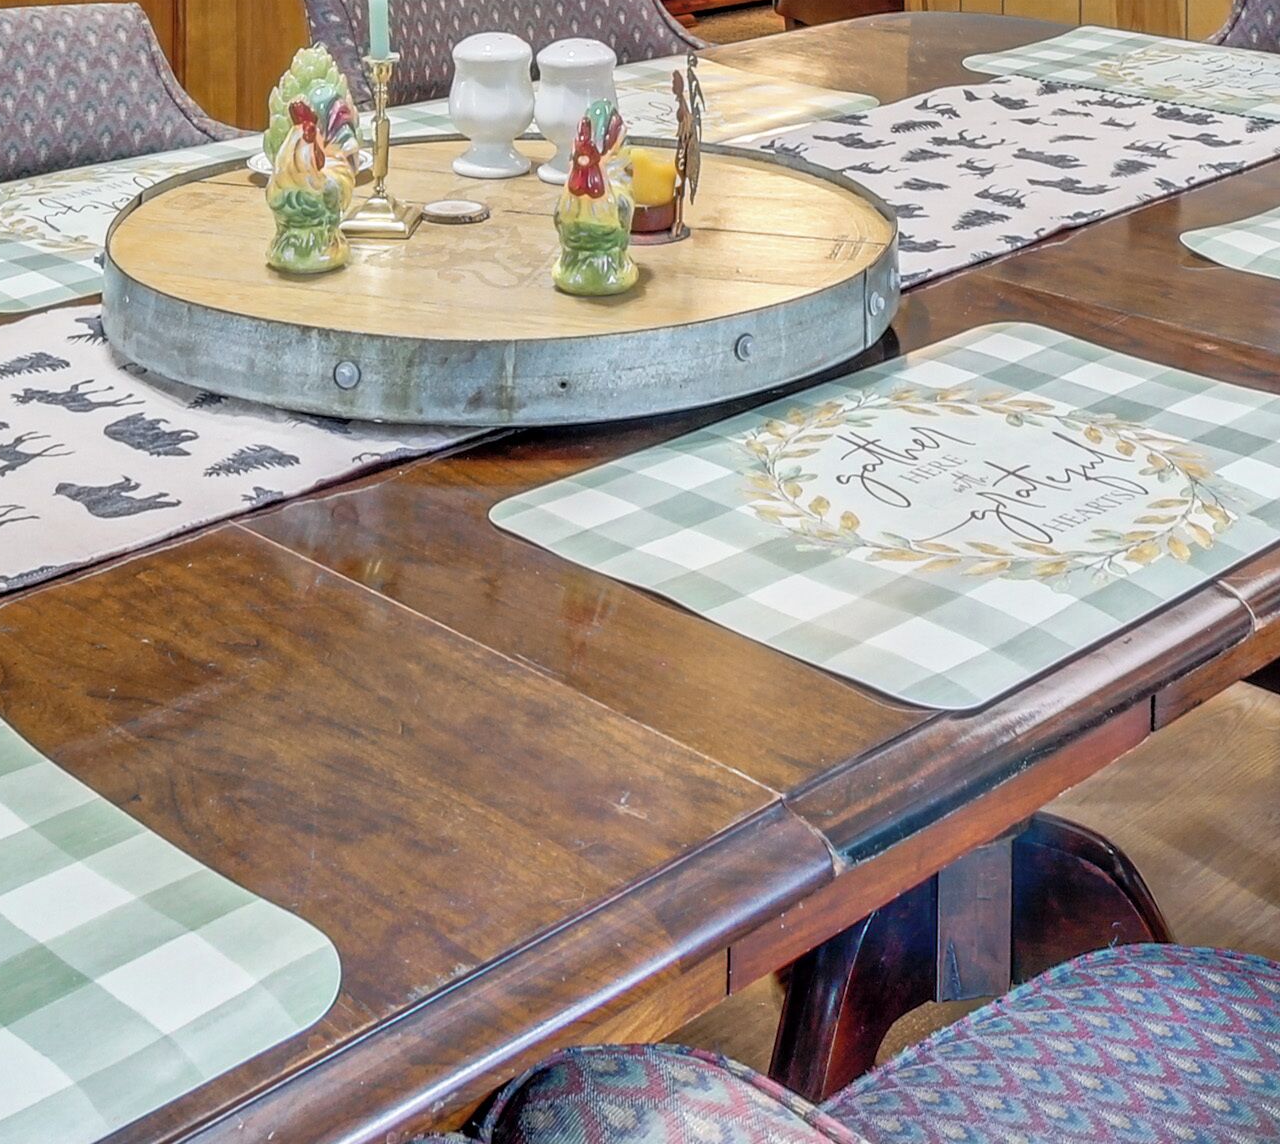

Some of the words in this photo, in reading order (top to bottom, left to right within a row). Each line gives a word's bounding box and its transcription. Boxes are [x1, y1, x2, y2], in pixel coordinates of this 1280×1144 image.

[836, 426, 976, 508] gather
[898, 453, 968, 486] HERE
[912, 431, 1148, 544] grateful
[1043, 486, 1138, 534] HEARTS
